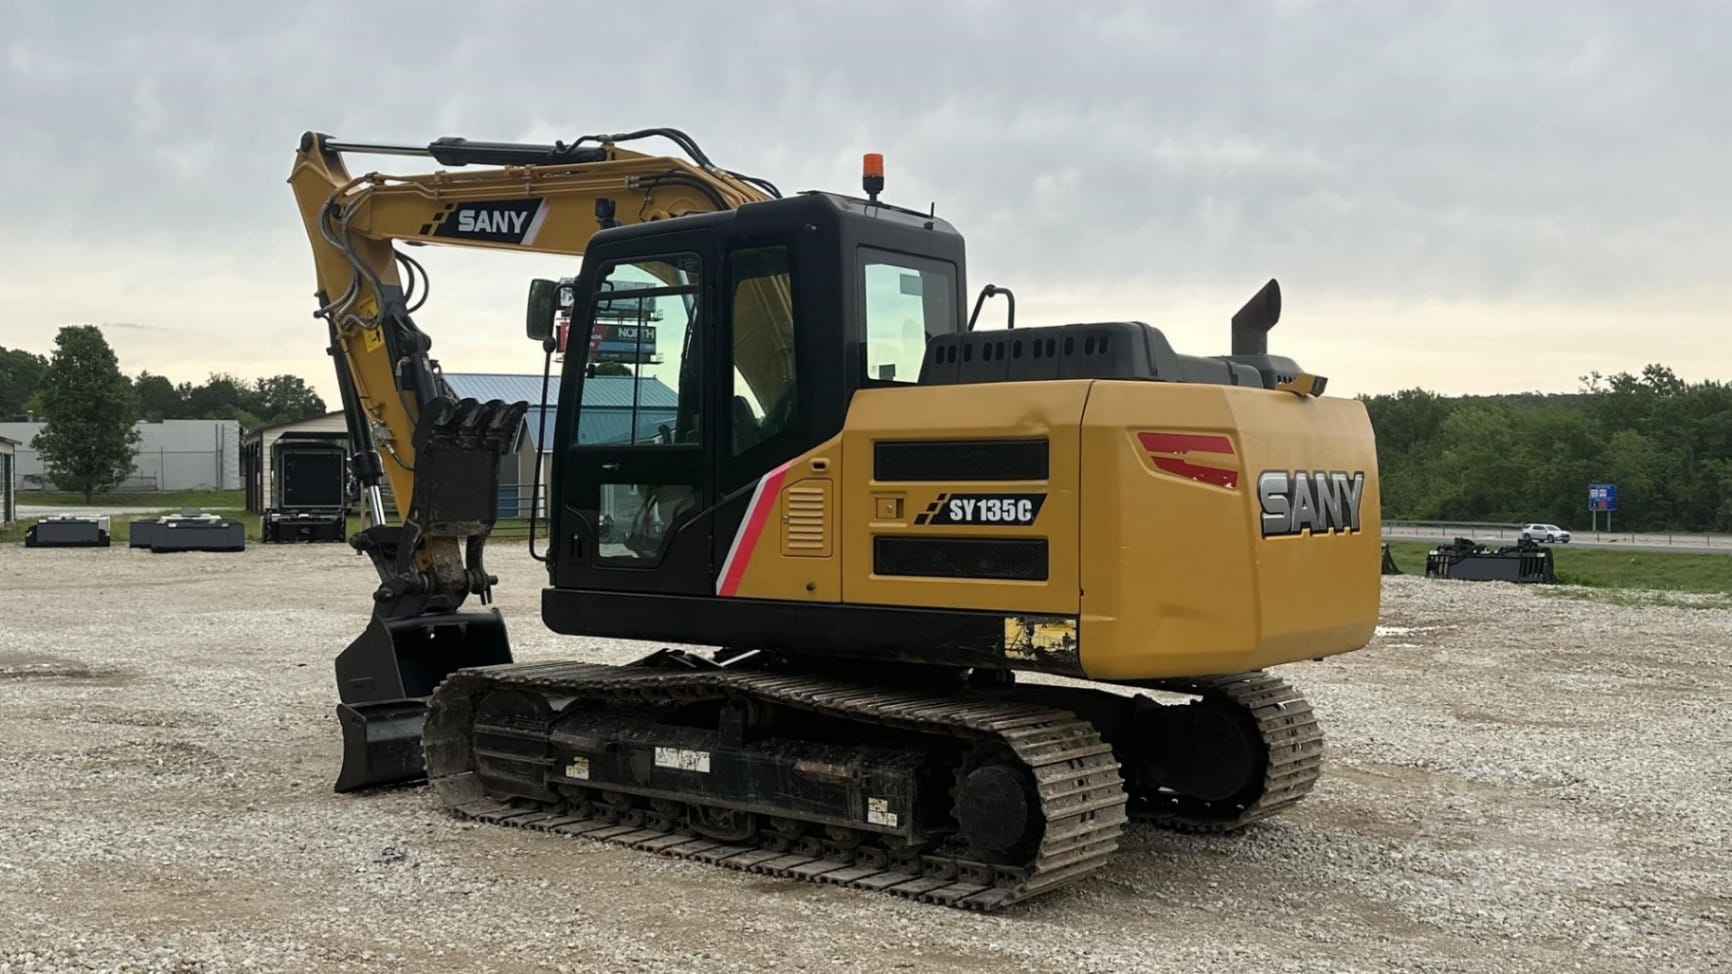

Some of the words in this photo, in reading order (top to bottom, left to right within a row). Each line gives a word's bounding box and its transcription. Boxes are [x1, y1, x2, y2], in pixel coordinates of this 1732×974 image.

[458, 209, 528, 234] SANY
[949, 499, 1032, 522] SY135C
[1258, 470, 1363, 538] SANY
